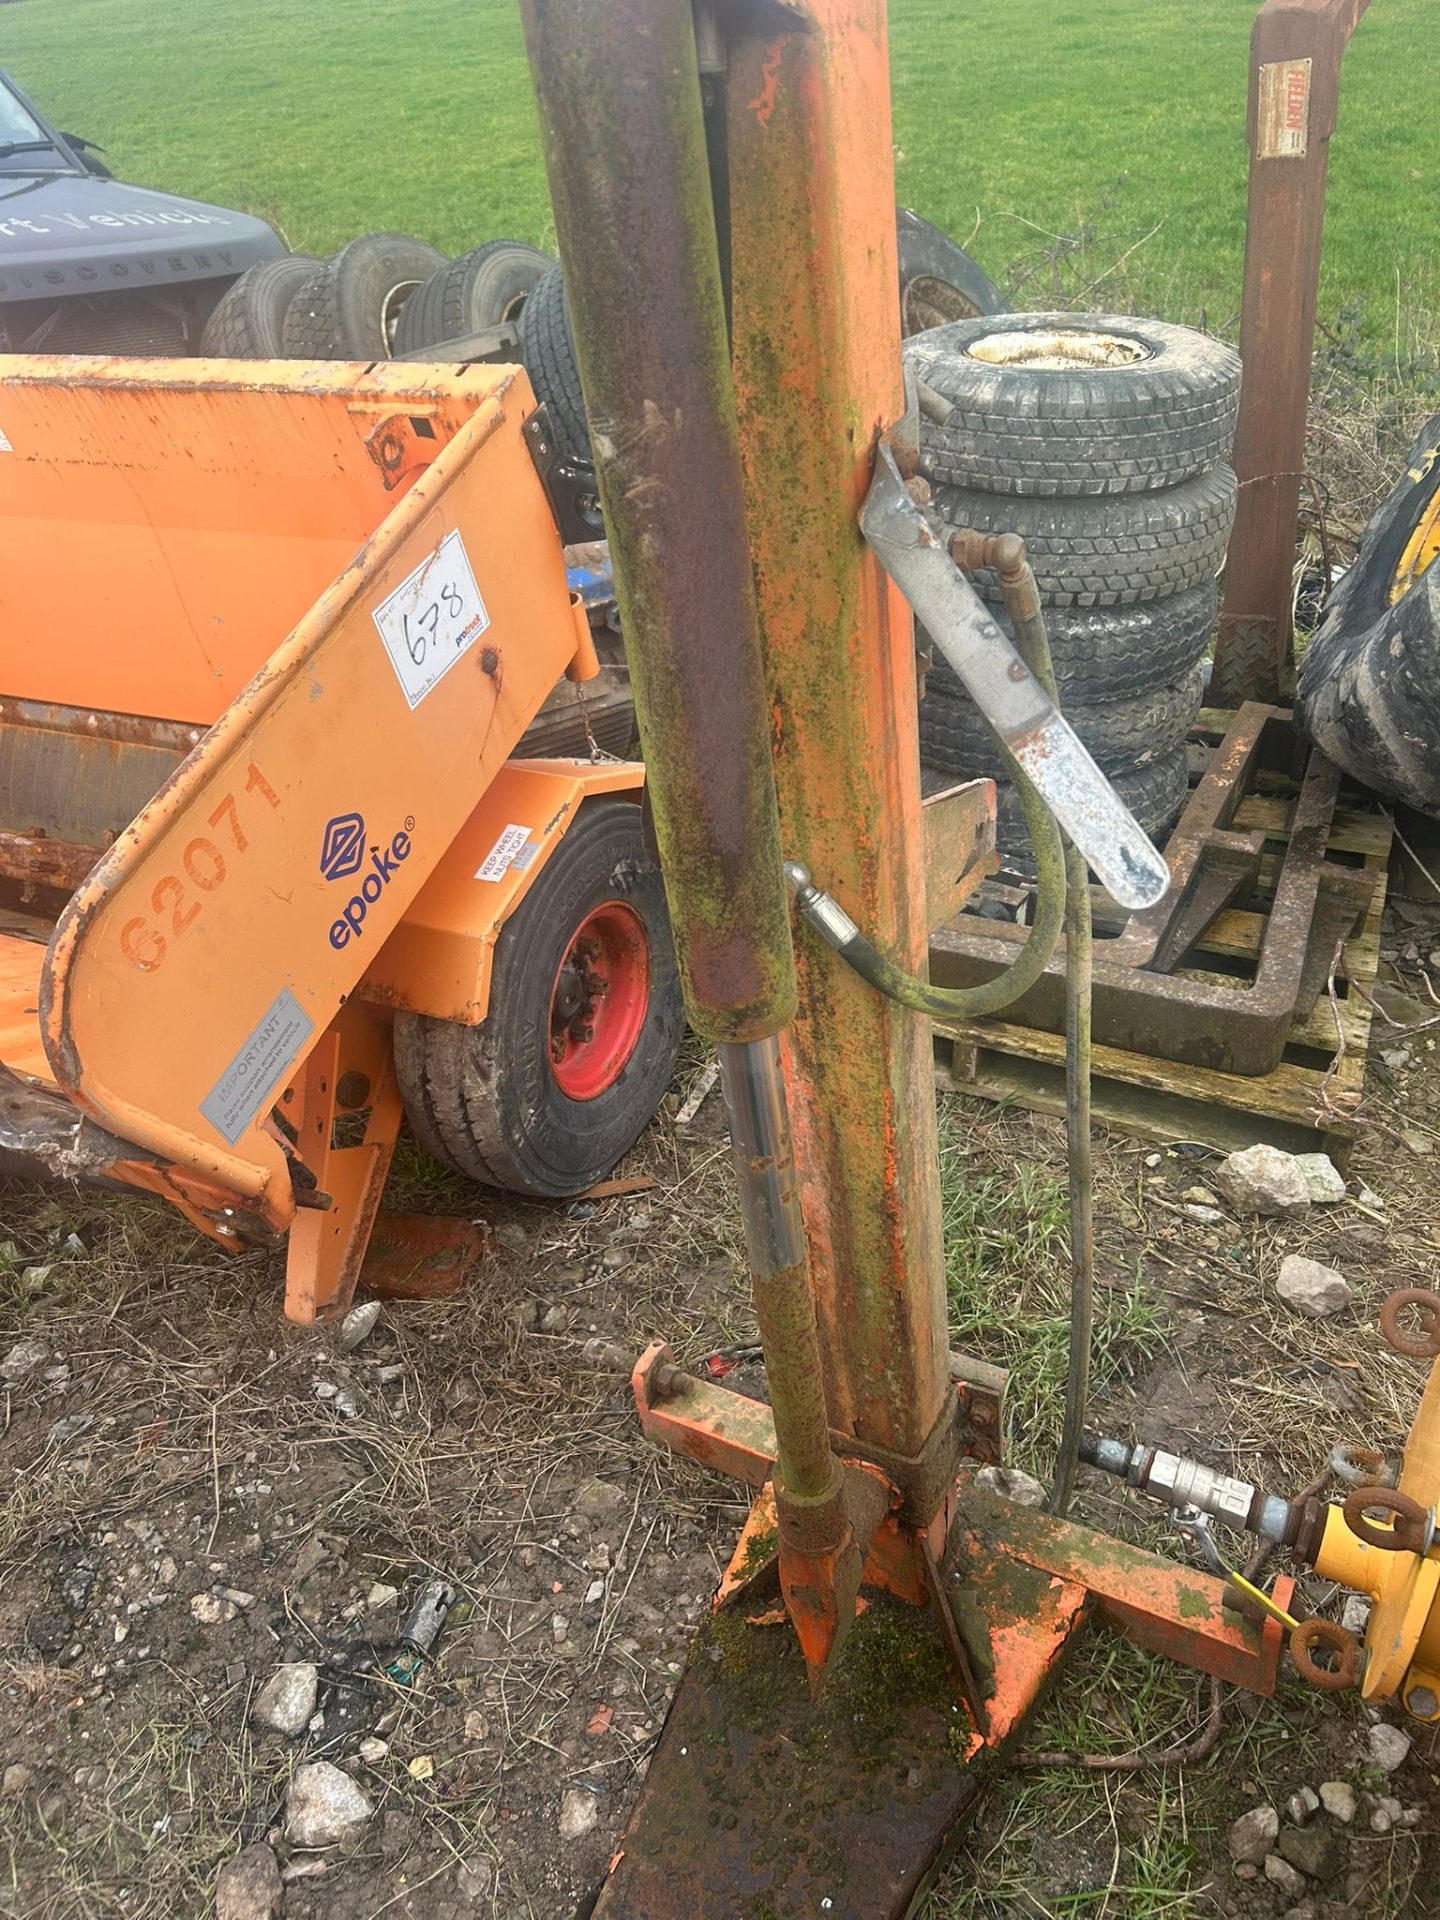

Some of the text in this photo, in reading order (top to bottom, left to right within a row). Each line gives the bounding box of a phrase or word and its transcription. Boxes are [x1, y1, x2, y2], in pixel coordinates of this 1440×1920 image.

[403, 581, 464, 666] 678
[455, 613, 482, 648] protruck
[120, 763, 281, 972] 62071
[481, 829, 517, 876] KEEP WHEEL
[493, 854, 512, 876] NUTS
[507, 832, 526, 854] TIGHT
[218, 1014, 281, 1104] IMPORTANT
[226, 1112, 240, 1130] fully
[239, 1089, 254, 1111] when
[254, 1057, 277, 1090] attached
[275, 1046, 283, 1058] to
[281, 1021, 302, 1048] vehicle
[240, 1066, 262, 1099] support
[261, 1020, 294, 1068] arrangement
